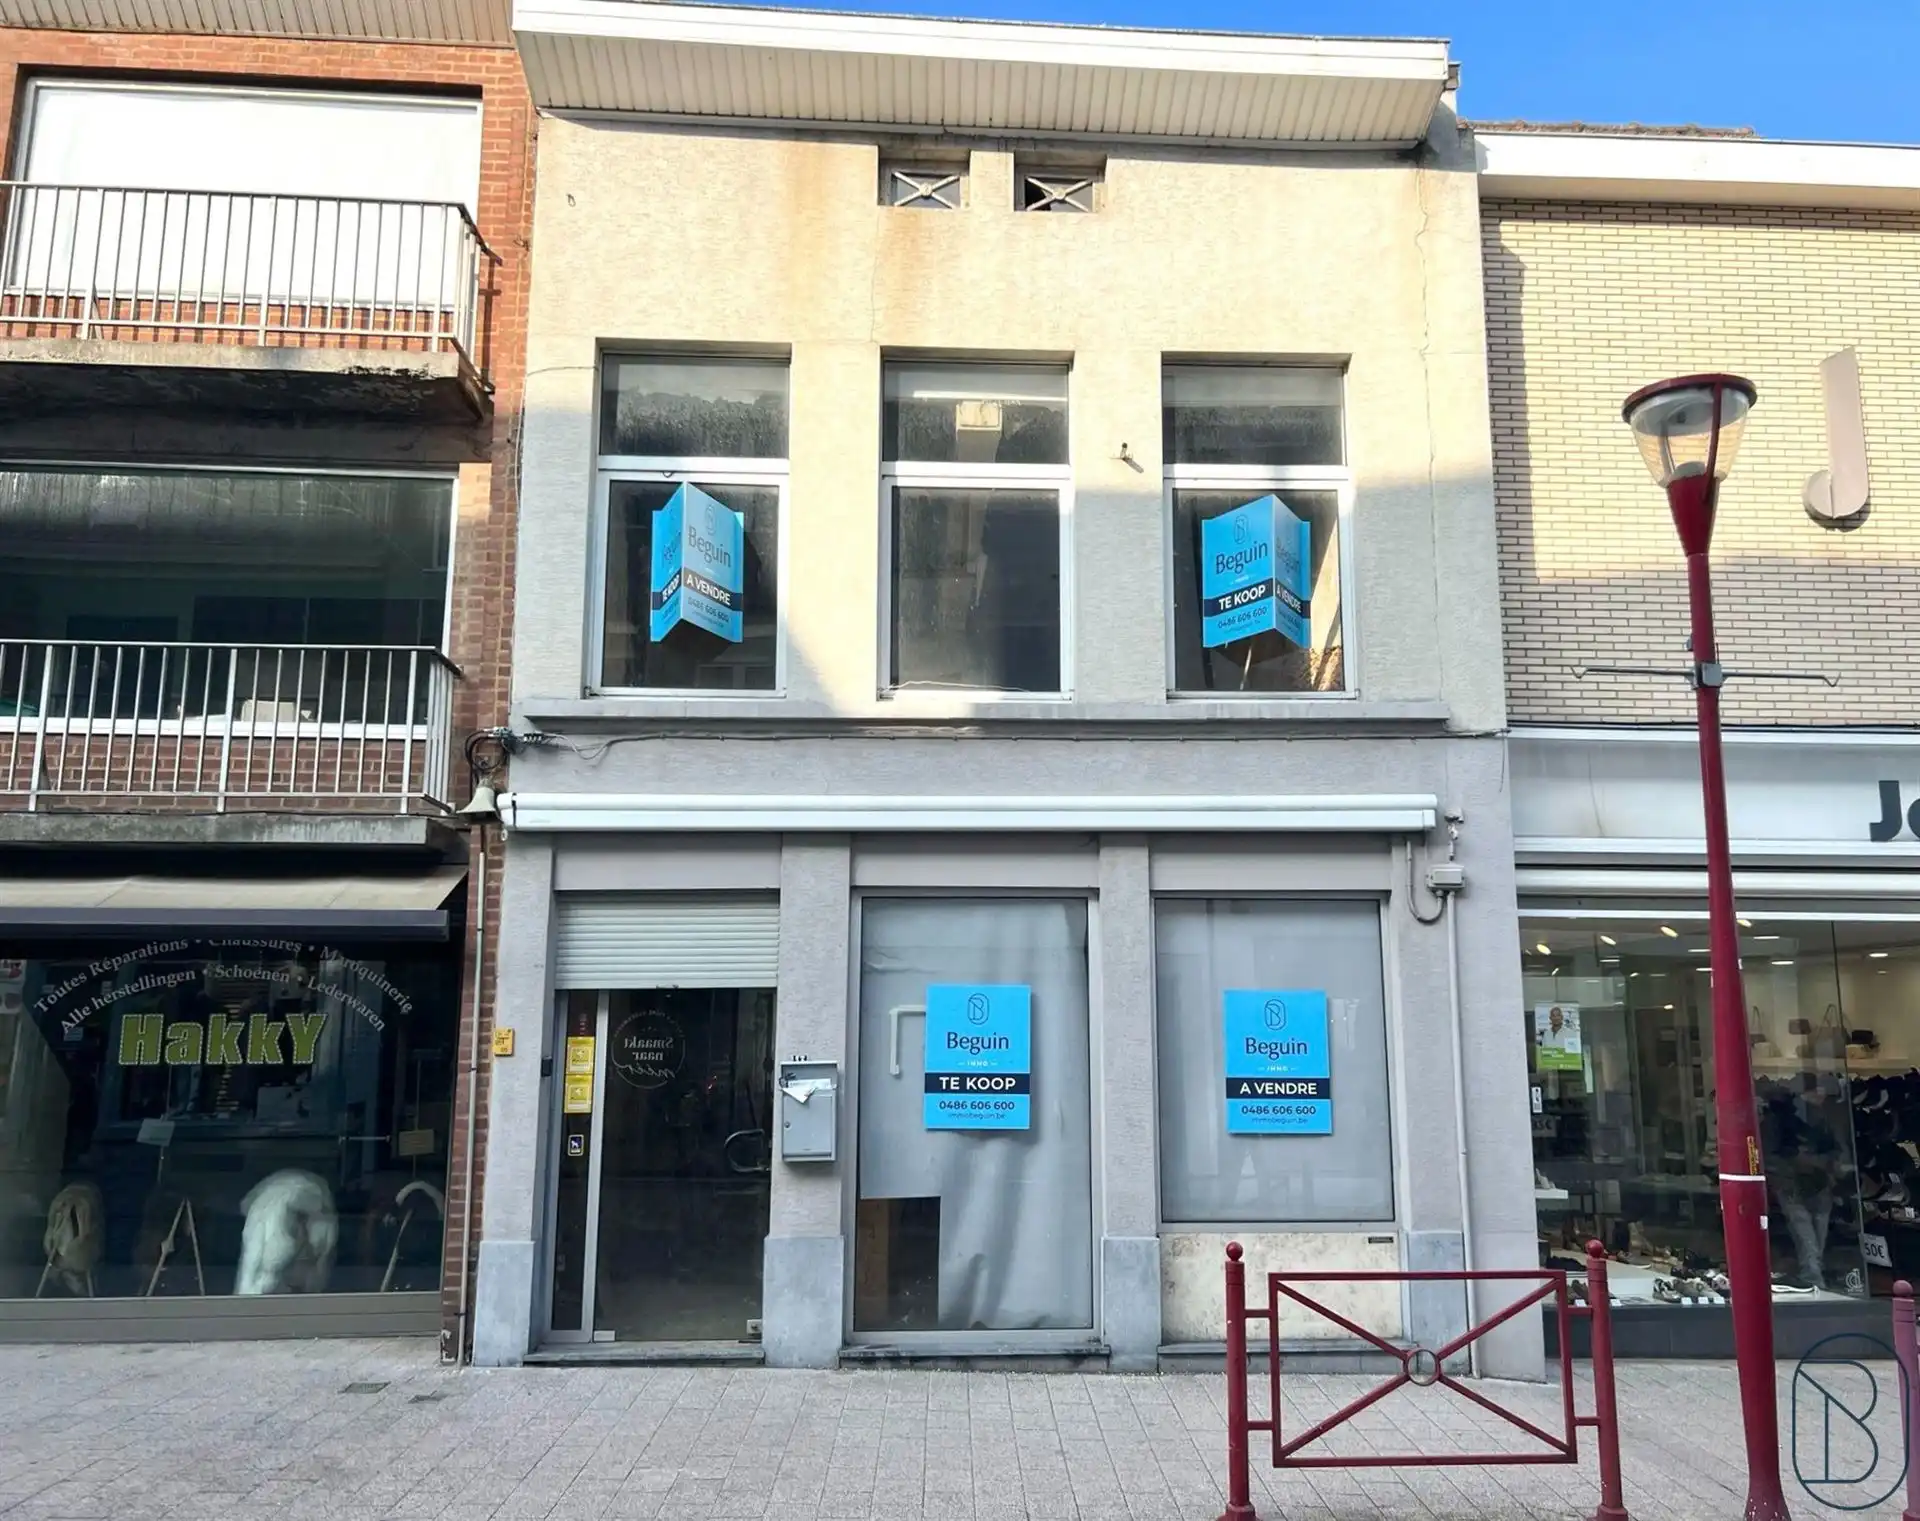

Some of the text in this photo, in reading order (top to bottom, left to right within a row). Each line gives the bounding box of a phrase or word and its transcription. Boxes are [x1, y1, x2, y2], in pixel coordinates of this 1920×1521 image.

[688, 526, 731, 568] Beguin
[1215, 541, 1268, 574] Beguin
[686, 574, 731, 606] A VENDRE
[1218, 585, 1266, 611] TE KOOP
[34, 972, 88, 1013] Toutes
[89, 938, 189, 977] Réparations
[320, 945, 413, 1014] Maroquinerie
[60, 964, 386, 1034] Alle herstellingen Schoenen Lederwaren
[118, 1013, 327, 1065] HakkY
[947, 1032, 1009, 1055] Beguin
[1245, 1037, 1308, 1061] Beguin
[939, 1077, 1016, 1090] TE KOOP
[1240, 1082, 1317, 1095] A VENDRE
[939, 1101, 1015, 1110] 0486 606 600
[1241, 1105, 1316, 1115] 0486 606 600
[1865, 1242, 1885, 1258] 50€
